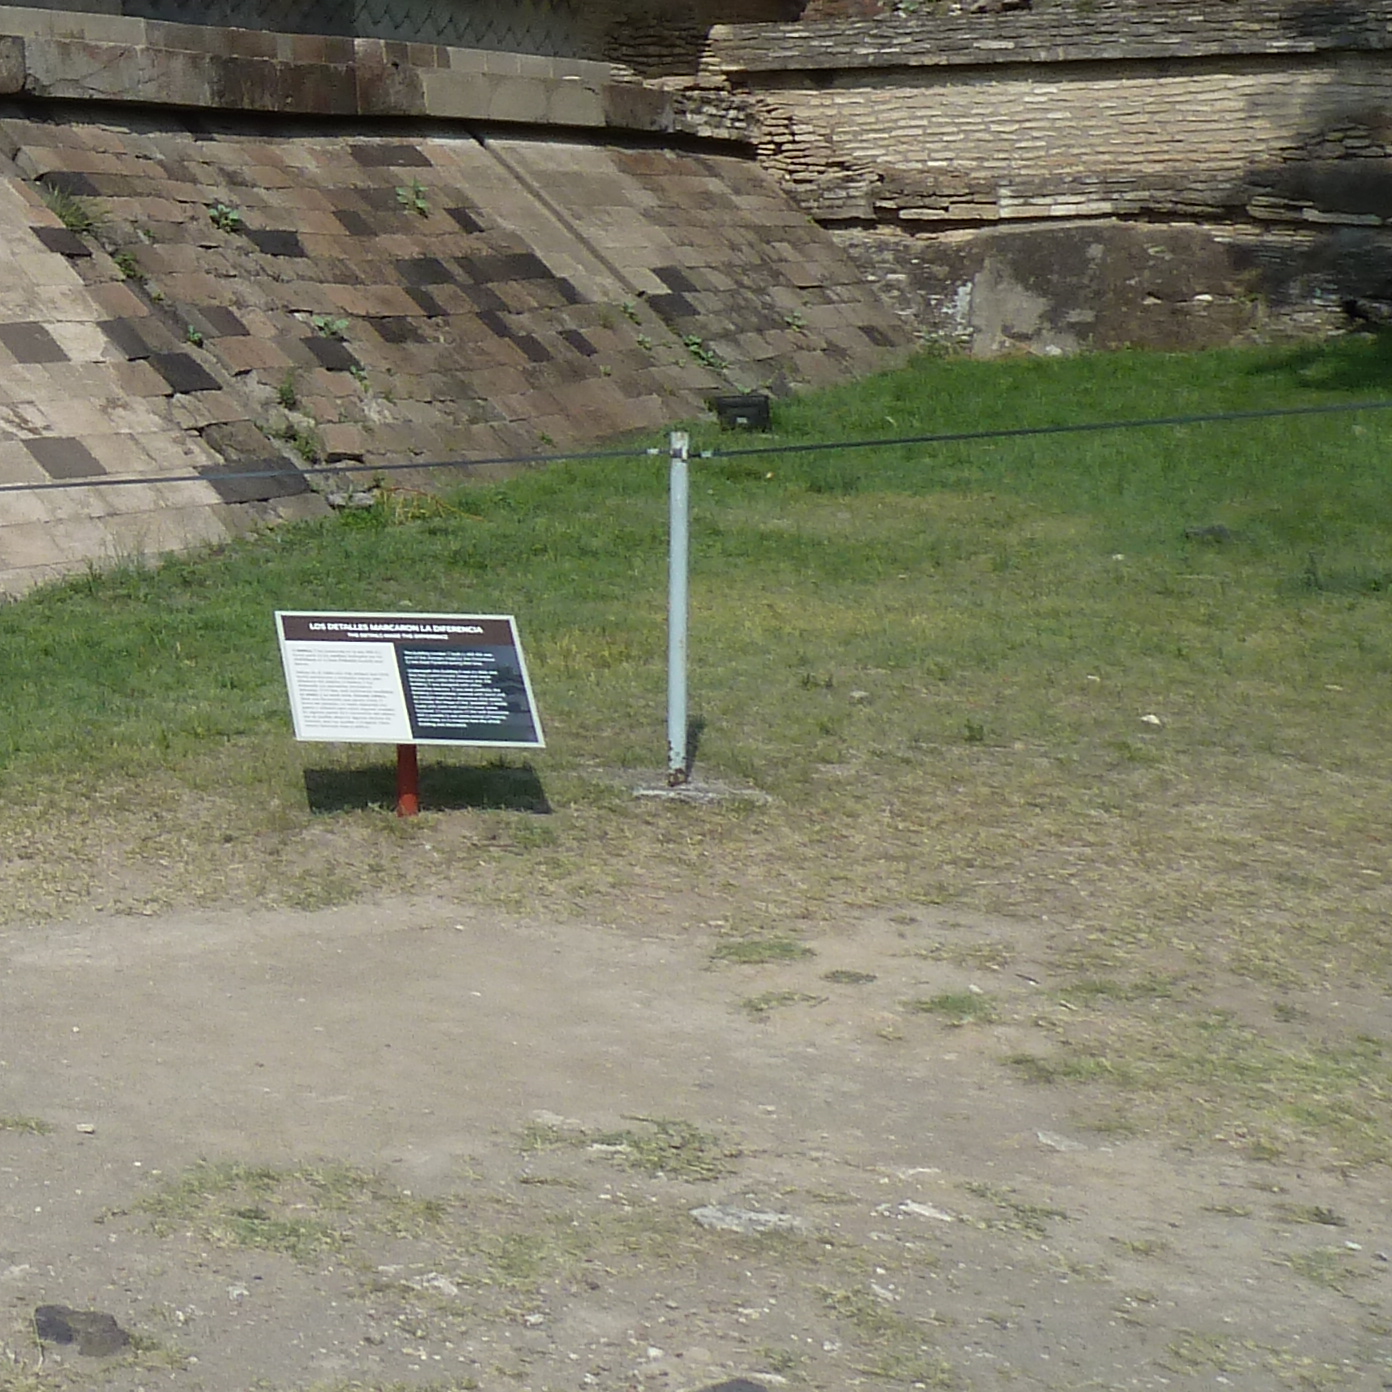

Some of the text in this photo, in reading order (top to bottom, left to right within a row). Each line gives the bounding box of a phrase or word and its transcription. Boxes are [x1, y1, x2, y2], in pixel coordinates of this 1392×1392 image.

[309, 622, 326, 631] LOS
[327, 622, 369, 631] DETALLES
[420, 624, 432, 633] LA
